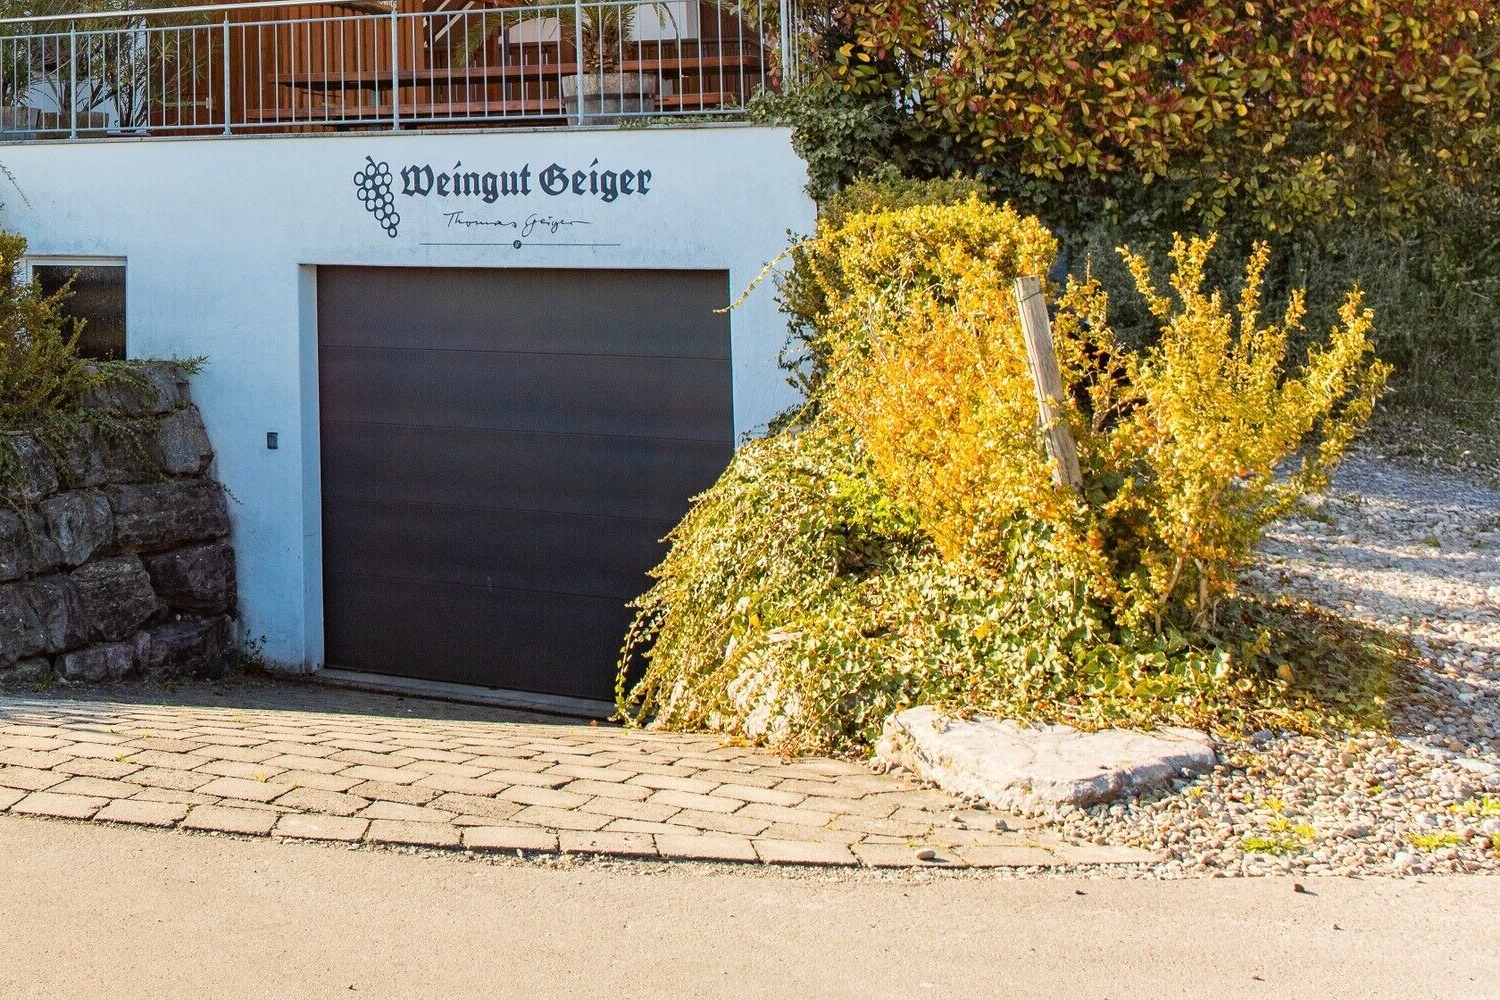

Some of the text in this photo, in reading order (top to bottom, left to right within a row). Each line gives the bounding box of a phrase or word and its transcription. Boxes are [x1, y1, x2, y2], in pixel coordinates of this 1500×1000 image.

[400, 158, 652, 203] Weingut Geiger
[443, 211, 592, 238] Thomas Geiger
